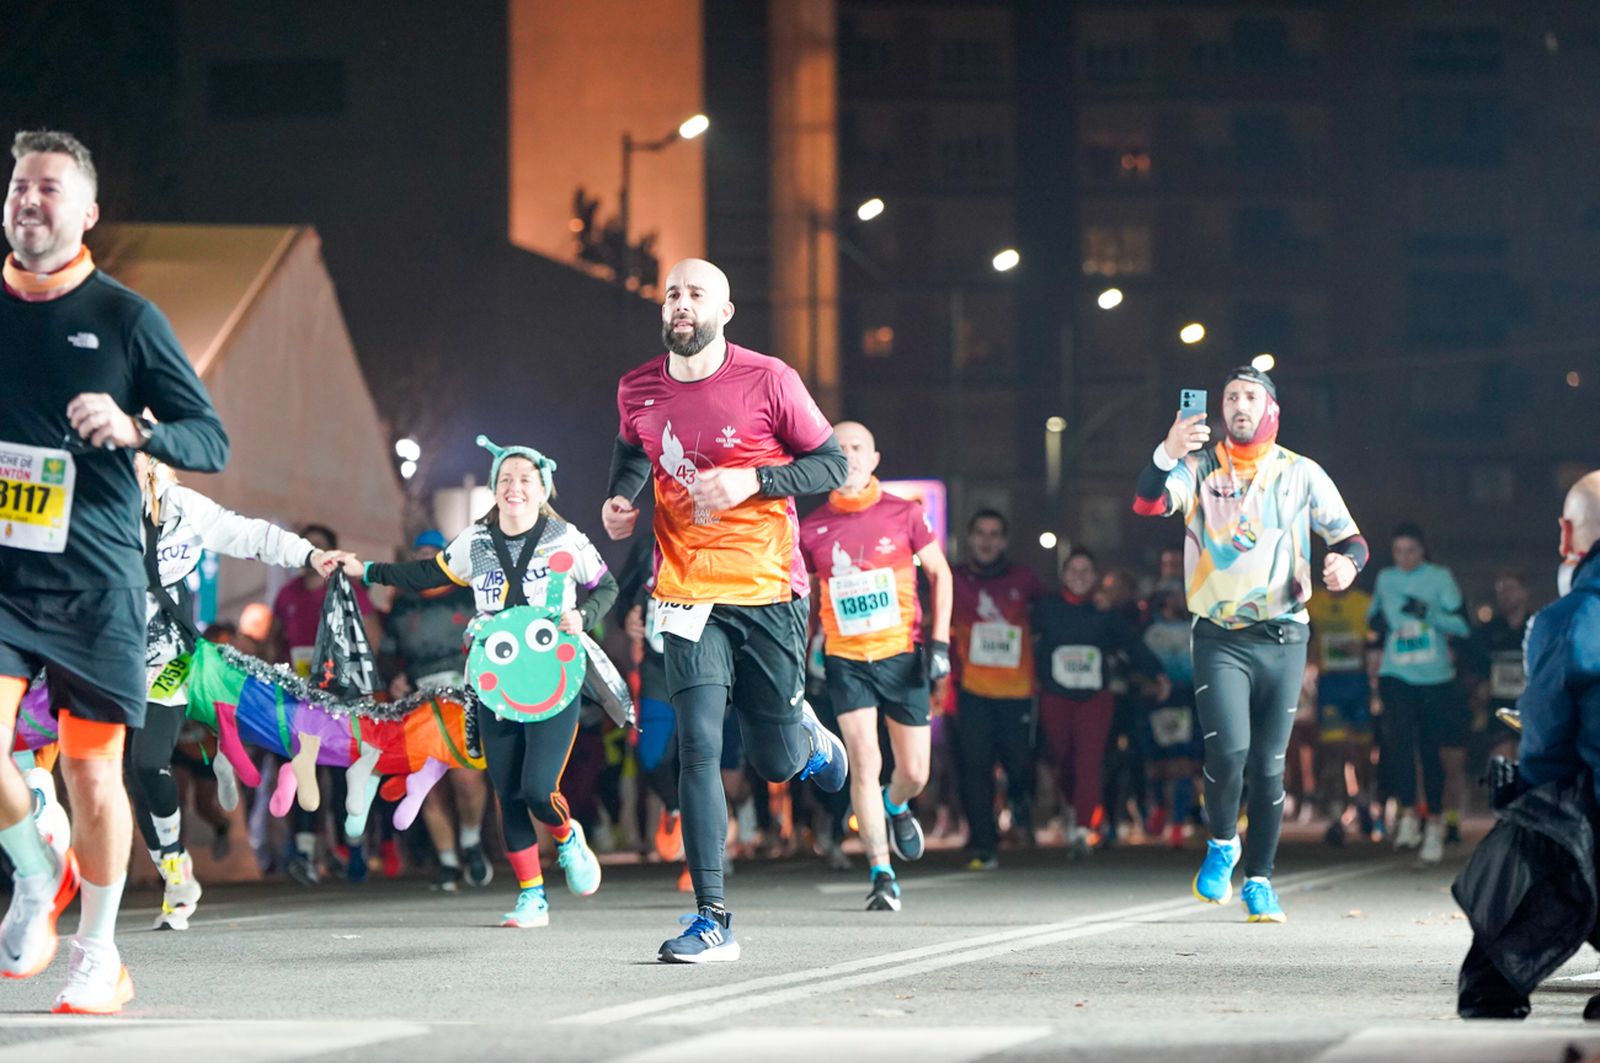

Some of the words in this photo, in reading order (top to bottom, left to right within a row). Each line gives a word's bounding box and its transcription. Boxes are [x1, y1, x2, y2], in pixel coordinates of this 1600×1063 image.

[0, 454, 18, 466] CHE
[676, 464, 696, 485] 43
[157, 544, 190, 561] CUZ
[840, 591, 889, 615] 13830
[152, 658, 187, 692] 7359
